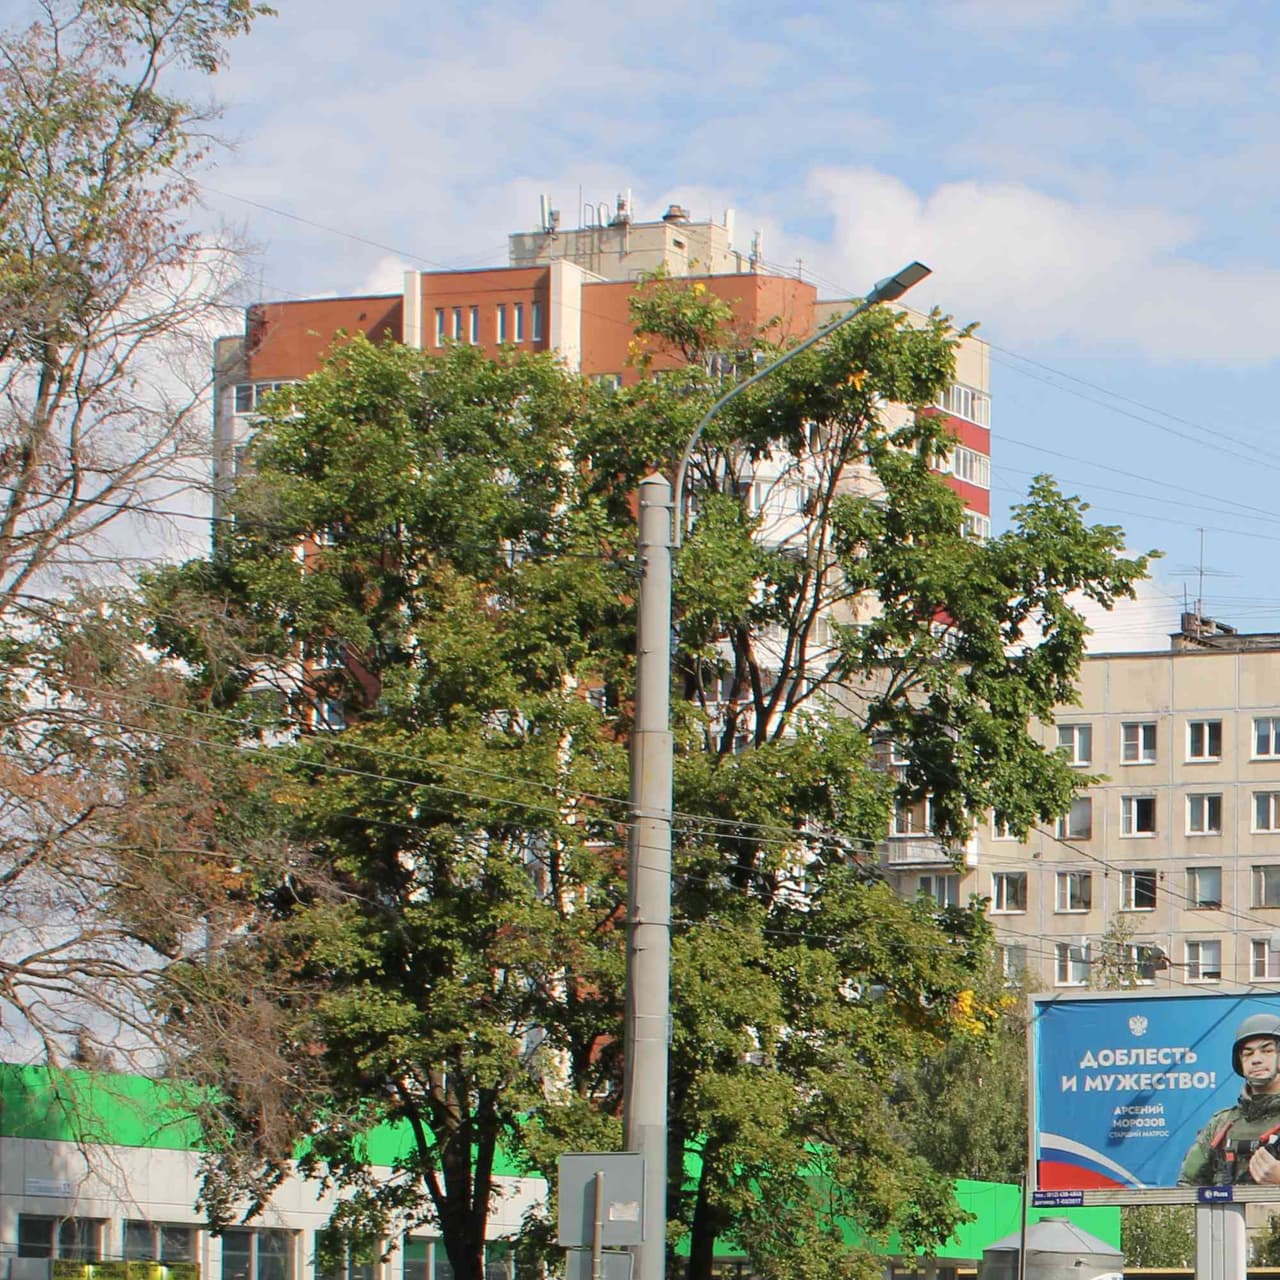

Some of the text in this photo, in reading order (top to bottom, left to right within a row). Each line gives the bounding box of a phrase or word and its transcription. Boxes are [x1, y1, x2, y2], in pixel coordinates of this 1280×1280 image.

[1079, 1048, 1197, 1069] ДОБЛЕСТЬ
[1062, 1072, 1217, 1092] И МУЖЕСТВО!
[1113, 1103, 1164, 1115] АРСЕНИЙ
[1113, 1118, 1166, 1128] МОРОЗОВ
[1142, 1130, 1169, 1138] МАТРОС
